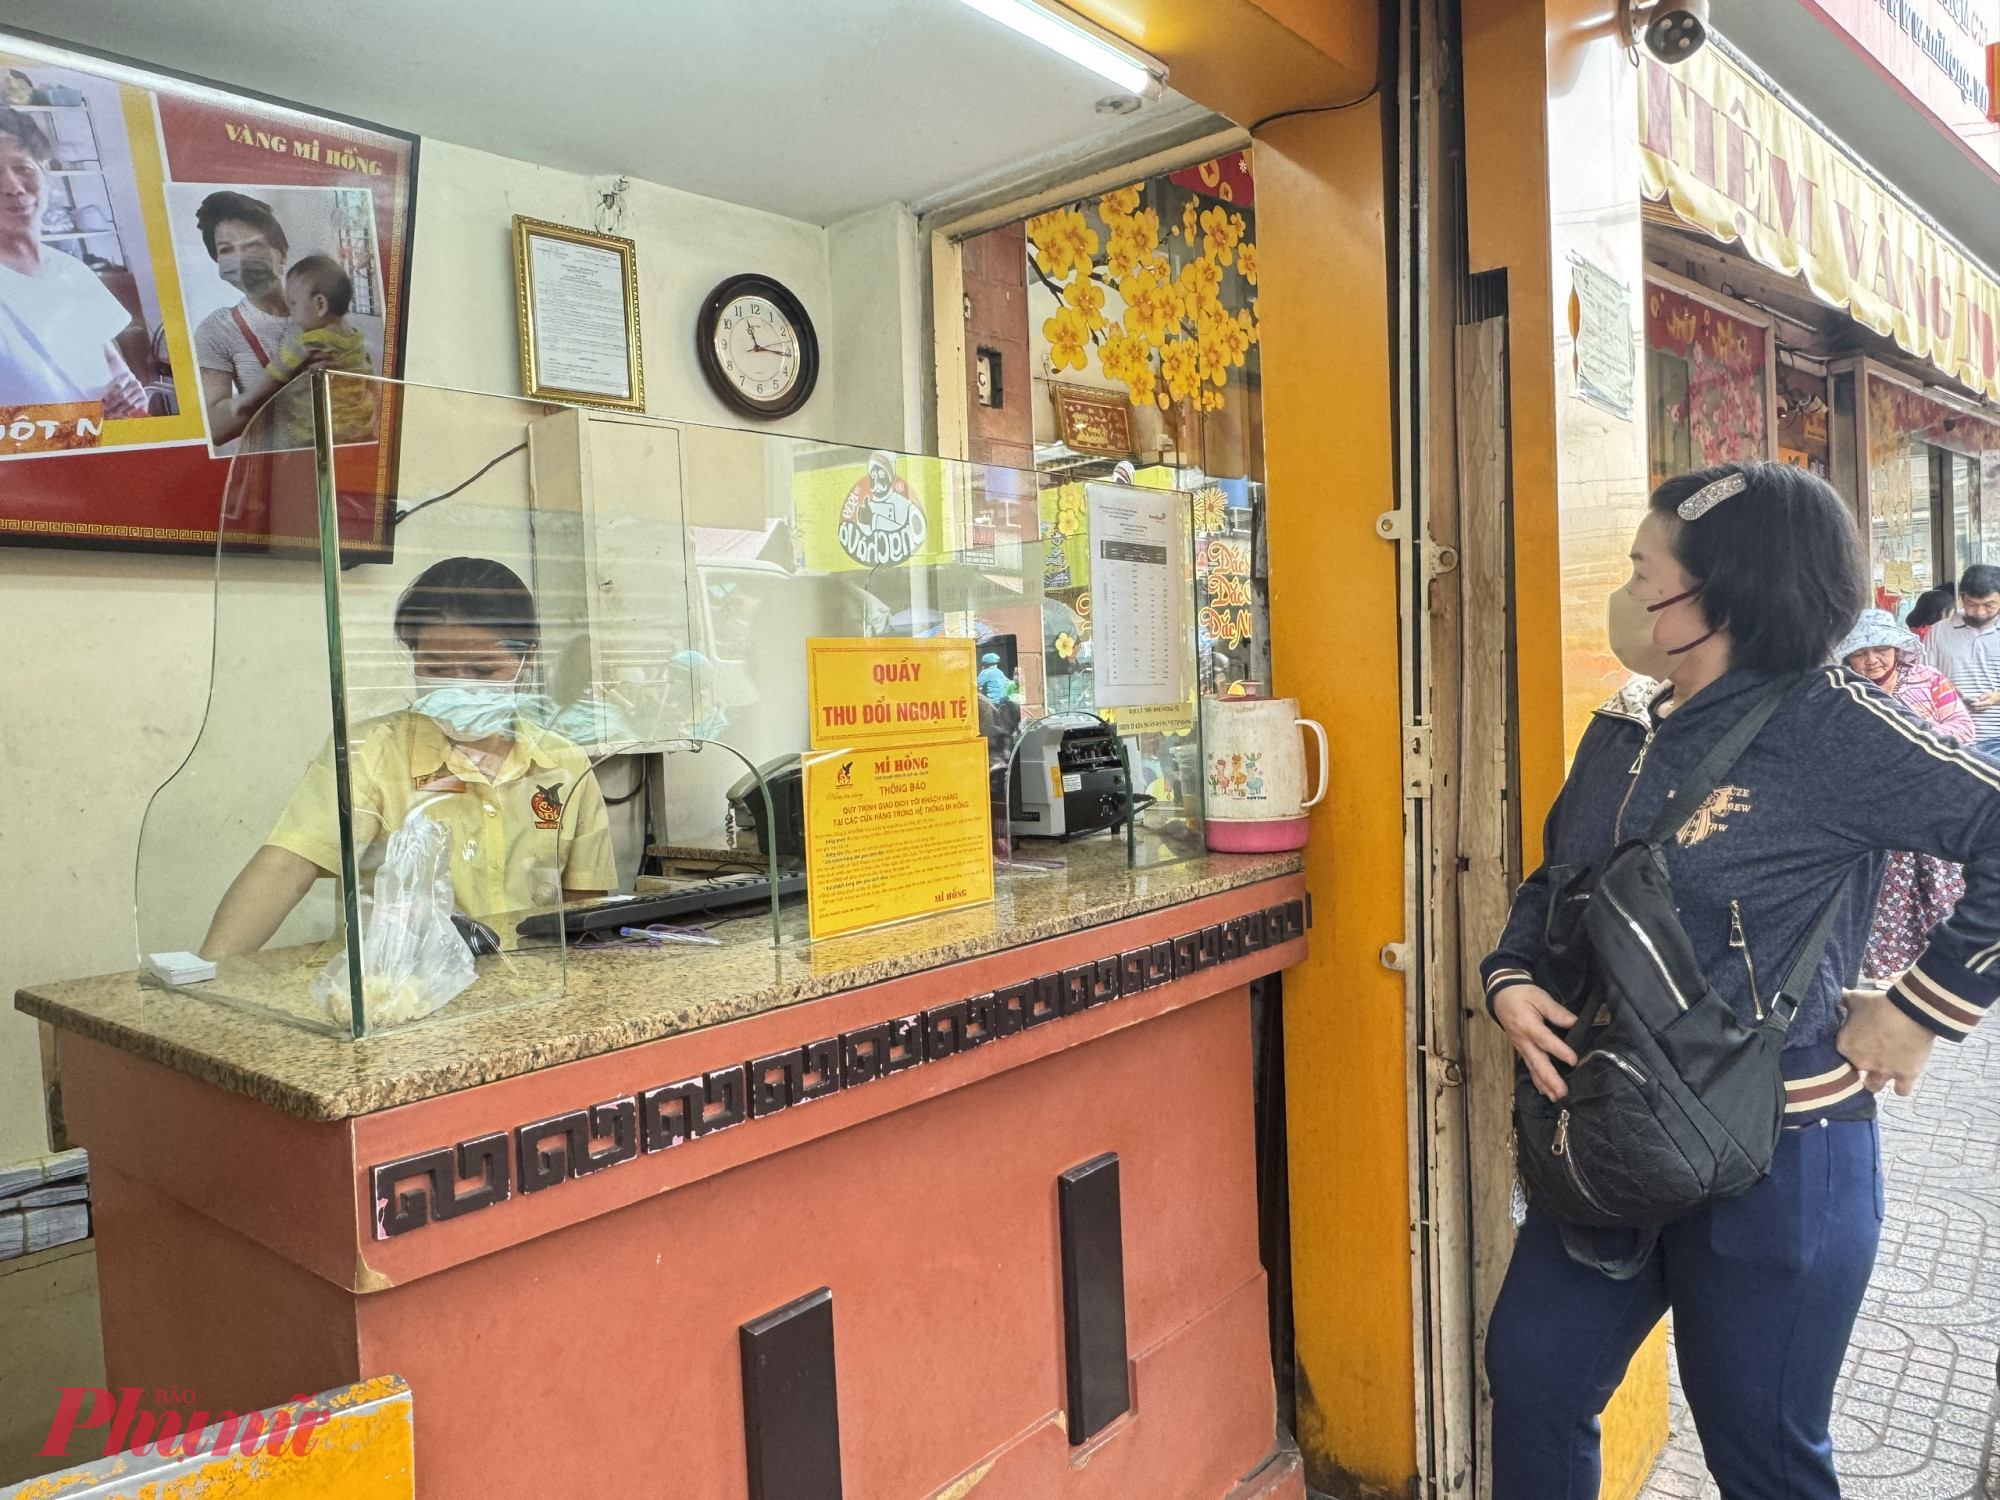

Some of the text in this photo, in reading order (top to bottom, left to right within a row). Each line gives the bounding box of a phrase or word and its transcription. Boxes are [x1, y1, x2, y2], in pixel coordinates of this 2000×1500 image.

[225, 123, 287, 153] VÀNG
[326, 146, 383, 176] HỒNG
[734, 305, 742, 317] 11
[750, 304, 760, 315] 12
[769, 312, 774, 323] 1
[723, 318, 732, 330] 10
[780, 326, 787, 337] 2
[721, 338, 728, 350] 9
[727, 360, 733, 372] 8
[782, 366, 788, 377] 4
[739, 375, 746, 387] 7
[773, 379, 779, 391] 5
[757, 383, 763, 394] 6
[823, 696, 968, 727] THU ĐỔI NGOẠI TỆ
[894, 752, 929, 772] HỒNG
[880, 781, 926, 796] THÔNG BÁO
[844, 816, 858, 826] CÁC
